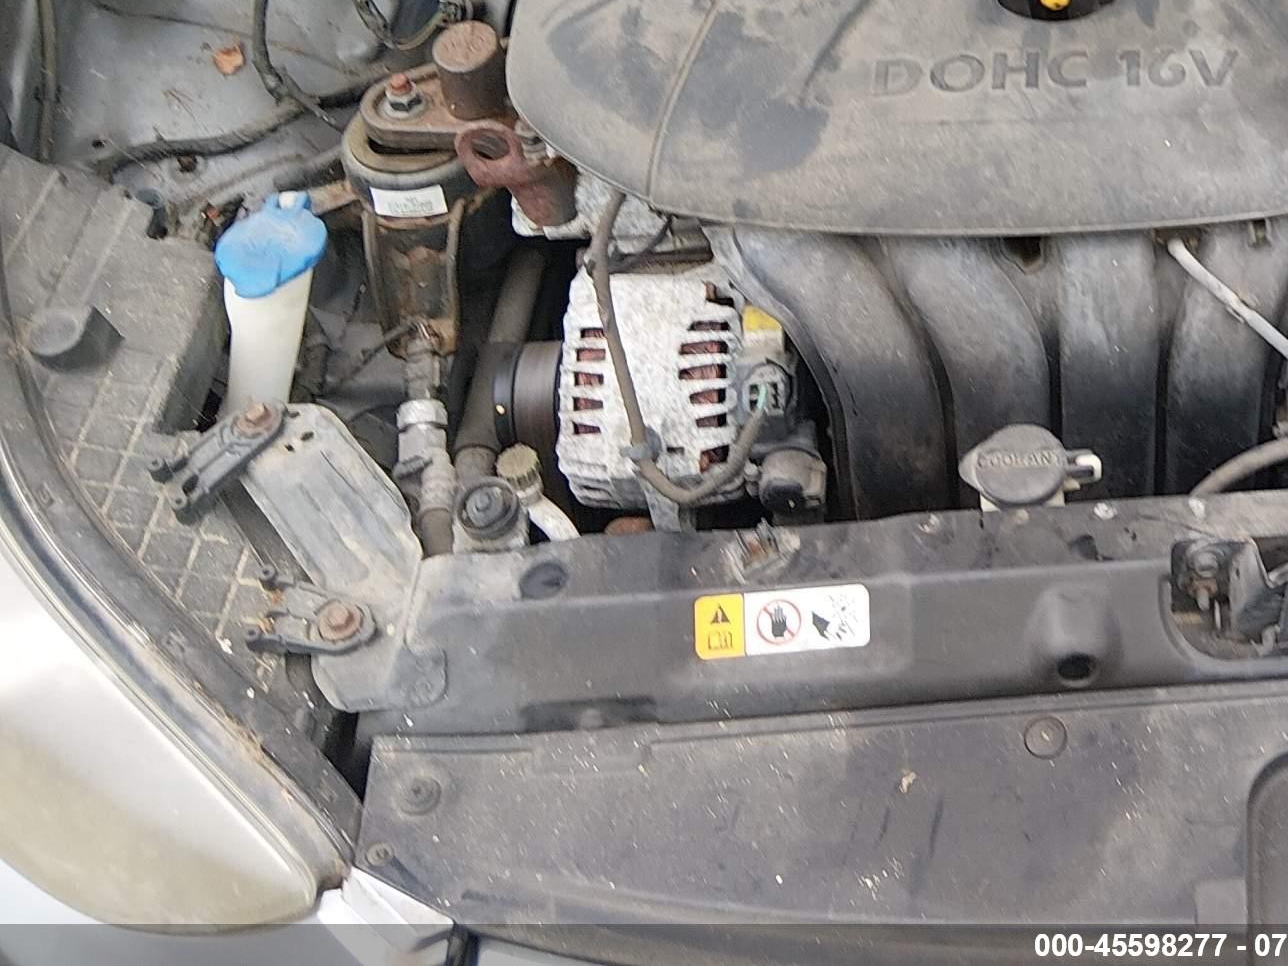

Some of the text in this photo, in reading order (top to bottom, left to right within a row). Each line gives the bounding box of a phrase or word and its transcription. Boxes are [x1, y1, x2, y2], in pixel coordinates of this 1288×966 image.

[872, 48, 1240, 97] DOHC 16V
[978, 449, 1061, 468] COOLANT
